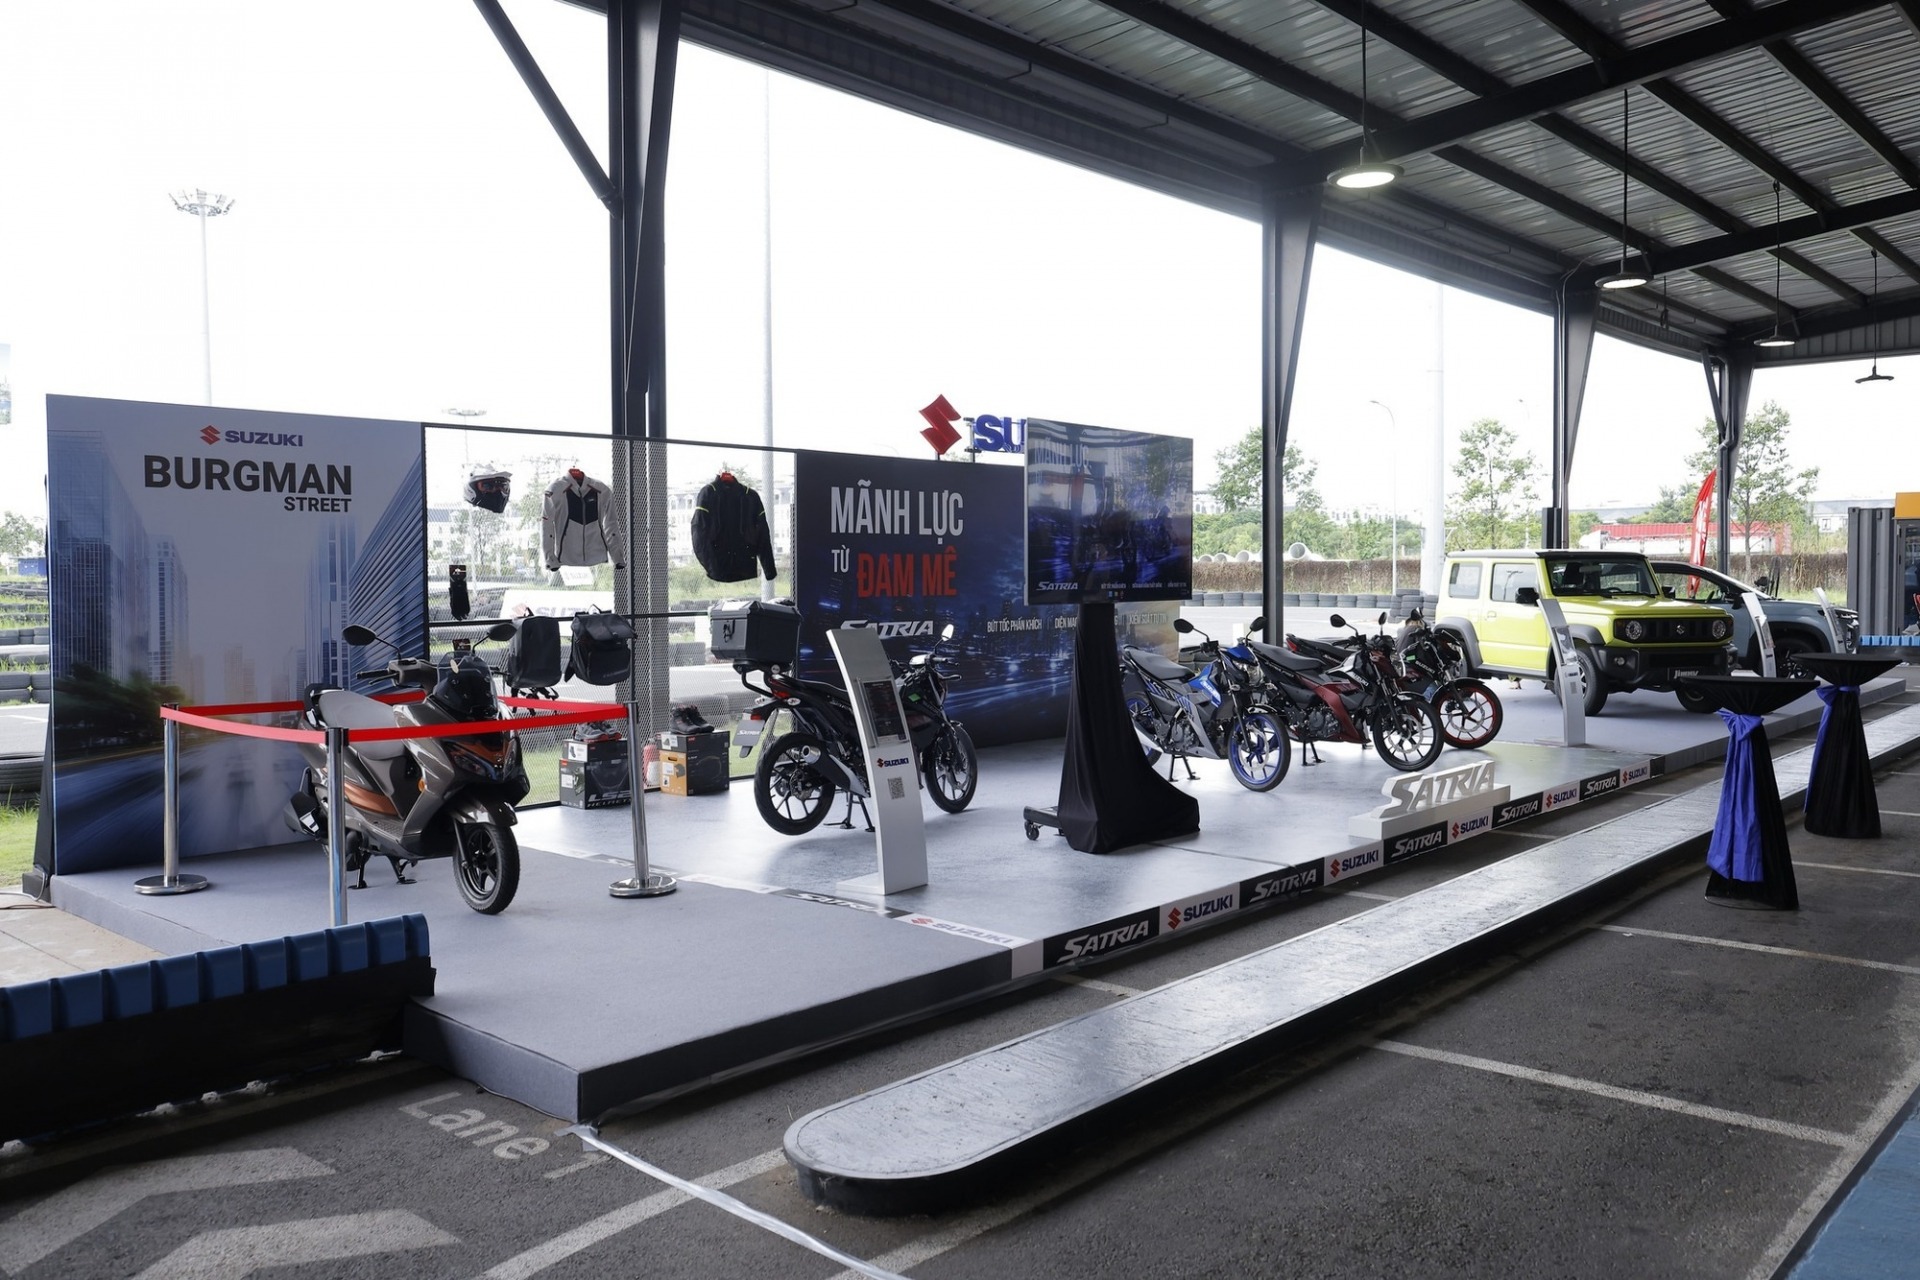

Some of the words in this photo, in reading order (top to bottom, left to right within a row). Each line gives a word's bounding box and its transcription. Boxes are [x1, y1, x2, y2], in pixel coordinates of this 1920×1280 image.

[225, 430, 303, 447] SUZUKI
[144, 454, 352, 496] BURGMAN
[284, 496, 352, 512] STREET
[831, 479, 910, 535] MÃNH
[919, 489, 964, 545] LỰC
[832, 544, 850, 573] TỪ
[857, 552, 914, 598] ĐAM
[922, 545, 957, 597] MÊ
[1036, 581, 1079, 591] SATRIA
[841, 620, 934, 640] TRIA
[1415, 660, 1436, 674] SUZUKI
[884, 758, 909, 767] SUZUKI
[1628, 766, 1648, 780] SUZUKI
[1379, 761, 1495, 818] SATRIA
[1553, 788, 1577, 804] SUZUKI
[1584, 775, 1617, 795] SATRIA
[1498, 800, 1538, 823] SATRIA
[1461, 816, 1489, 834] SUZUKI
[1391, 830, 1442, 858] SATRIA
[1341, 850, 1379, 872] SUZUKI
[1250, 869, 1317, 903] SATRIA
[1183, 894, 1233, 922] SUZUKI
[932, 922, 1013, 944] SUZUKI
[1058, 919, 1149, 963] SATRIA
[399, 1092, 550, 1159] Lane
